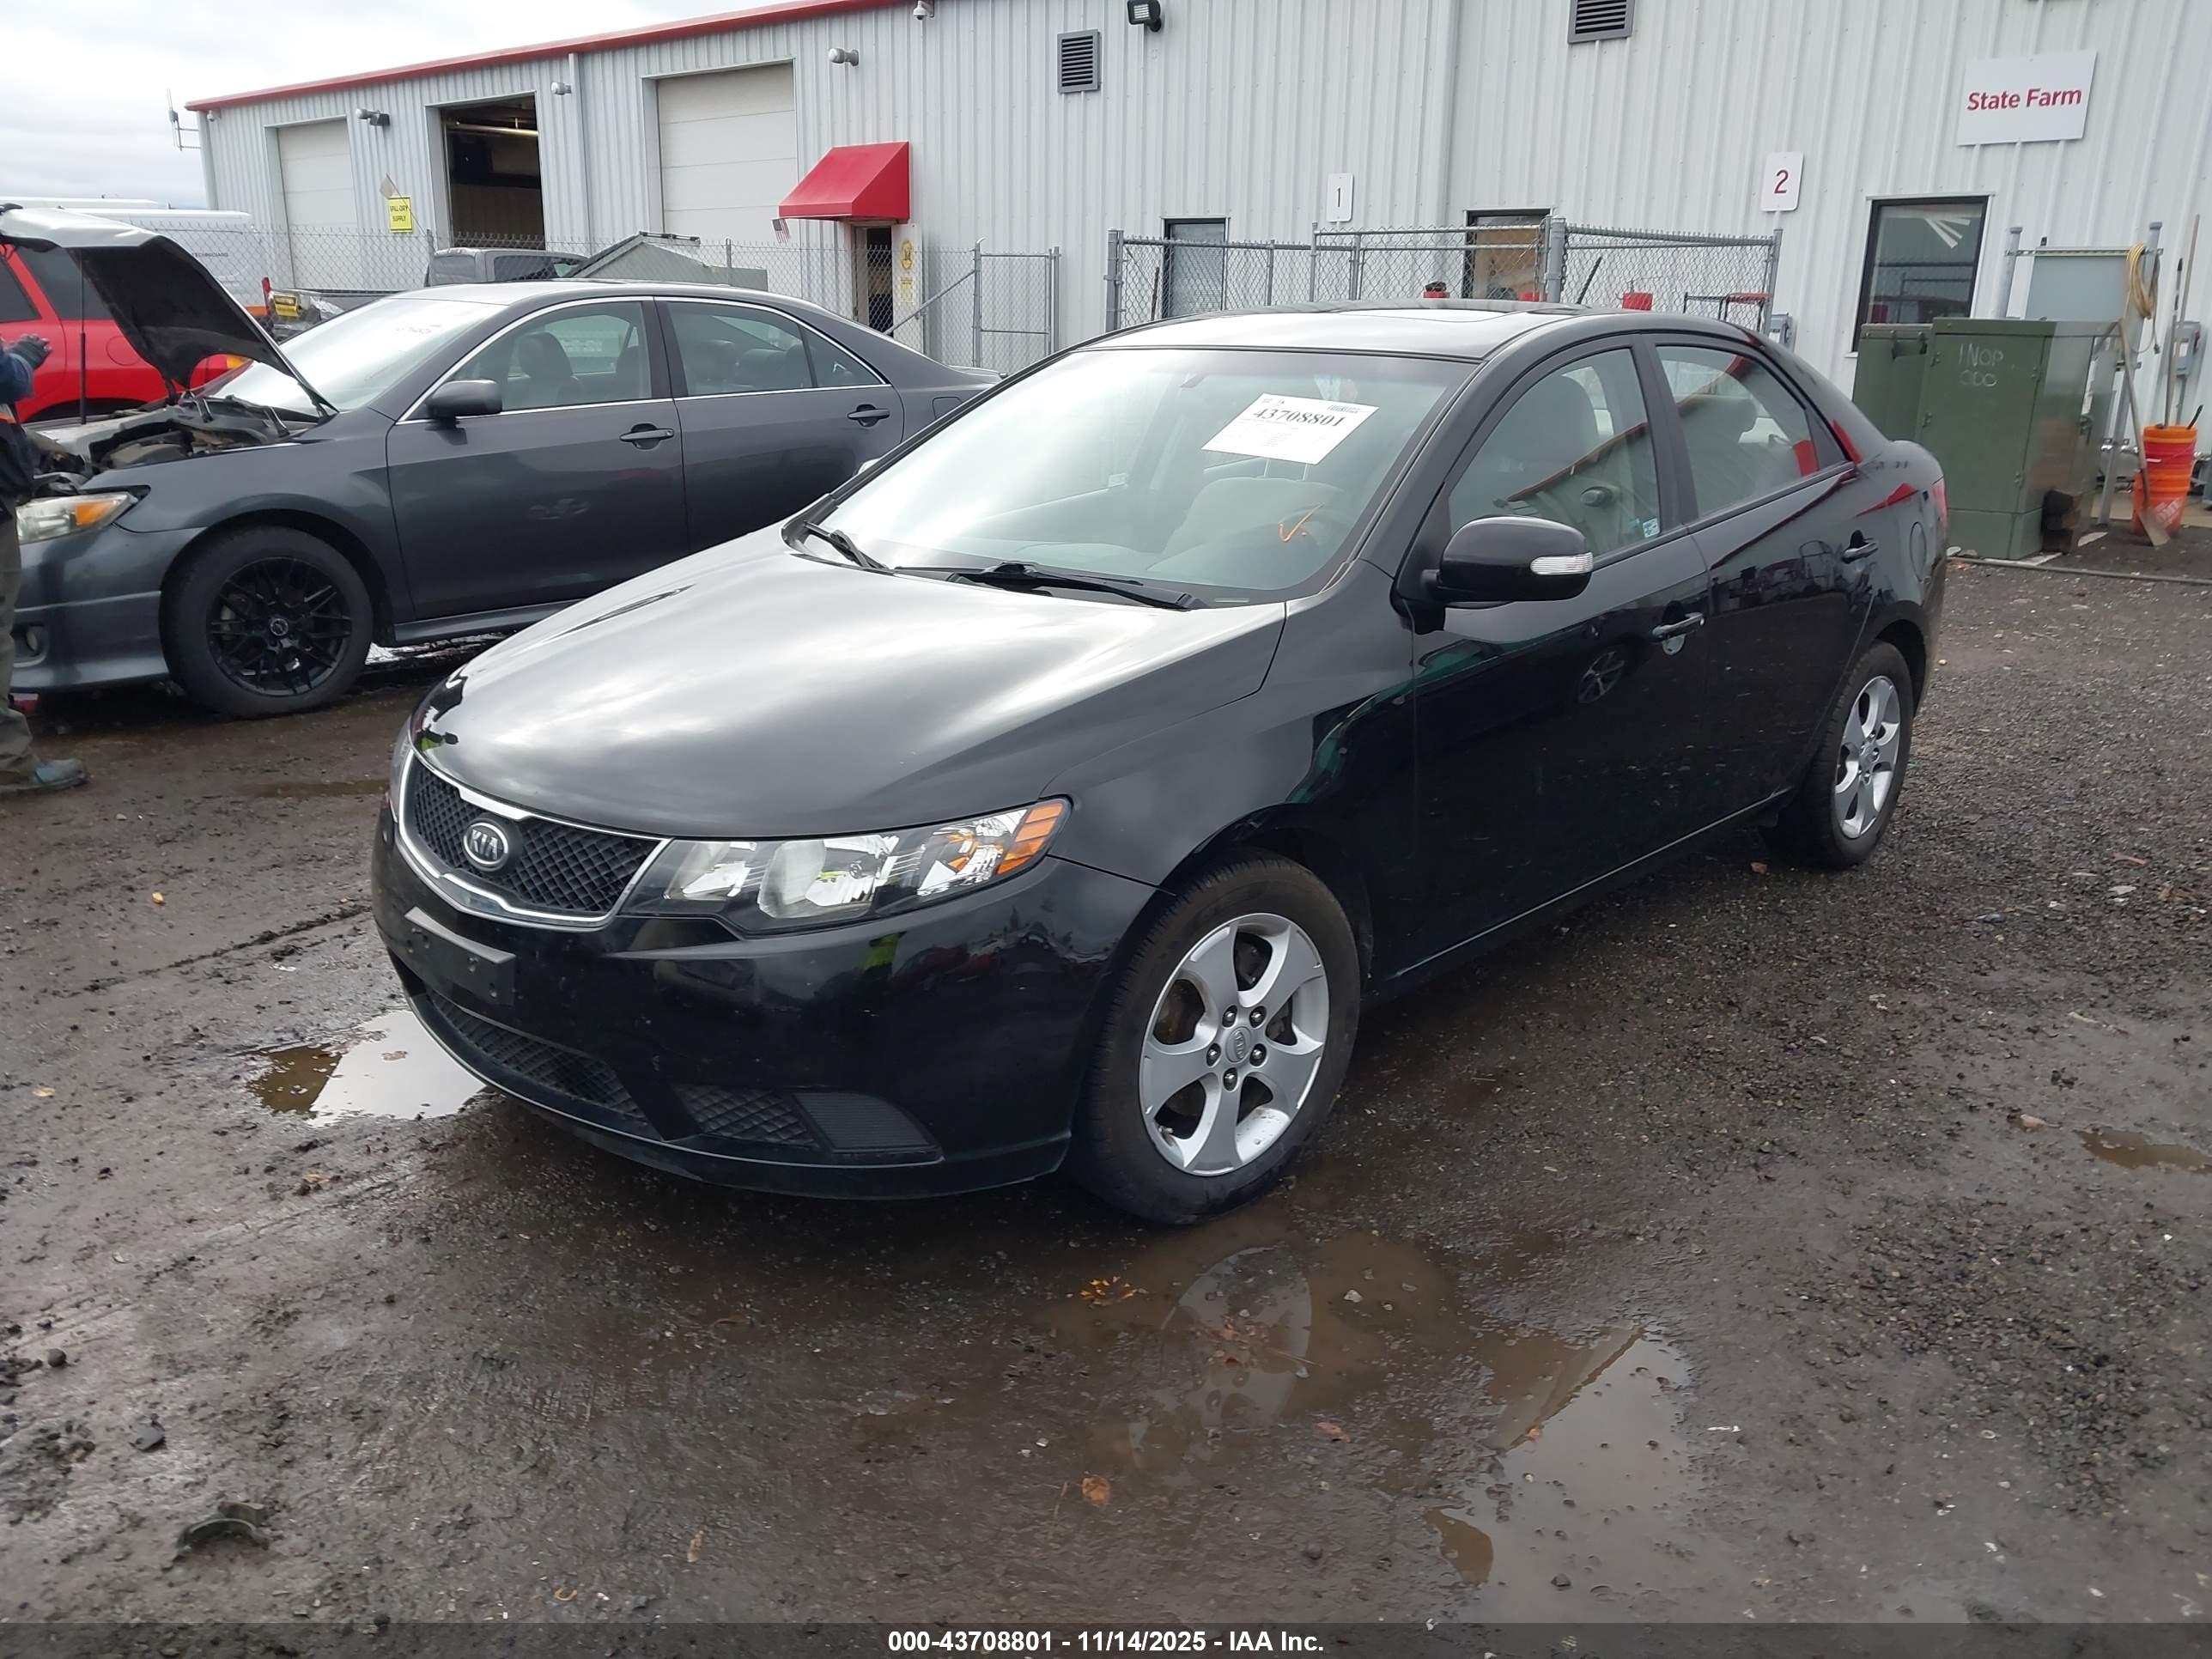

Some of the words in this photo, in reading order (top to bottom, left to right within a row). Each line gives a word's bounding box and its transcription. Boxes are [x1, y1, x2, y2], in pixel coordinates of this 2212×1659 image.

[1966, 90, 2021, 111] State
[2026, 88, 2082, 107] Farm
[1774, 169, 1789, 194] 2
[1336, 186, 1341, 208] 1
[1253, 407, 1346, 427] 43708801
[470, 829, 498, 860] KIA
